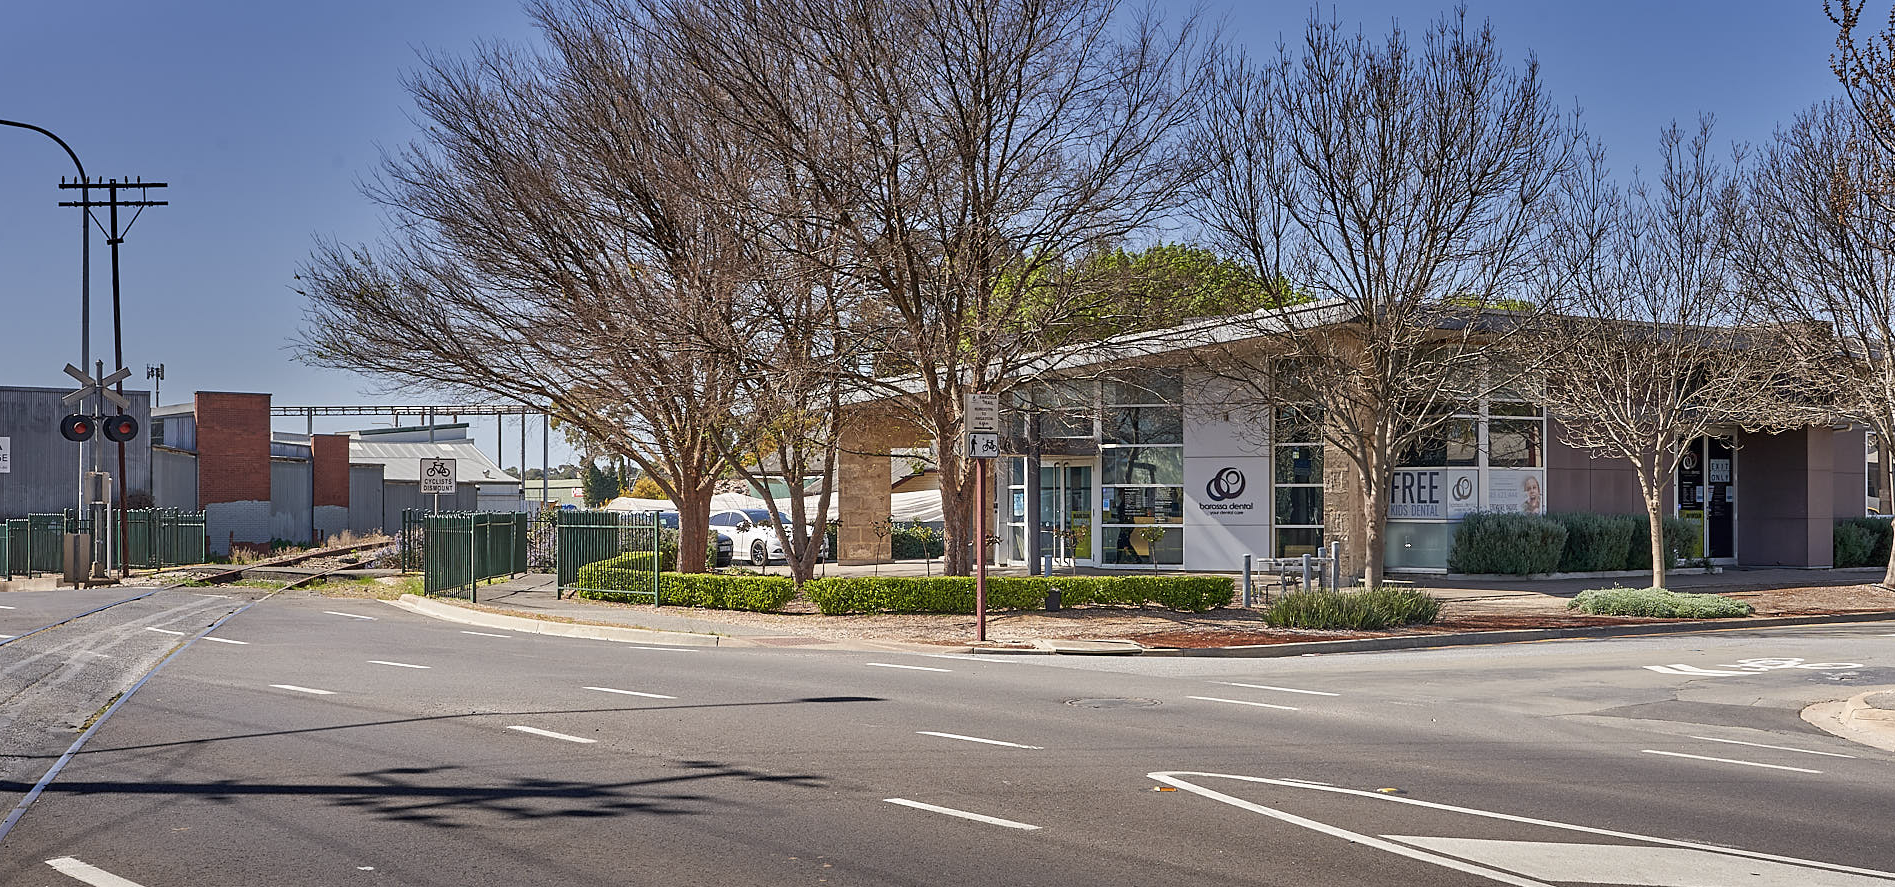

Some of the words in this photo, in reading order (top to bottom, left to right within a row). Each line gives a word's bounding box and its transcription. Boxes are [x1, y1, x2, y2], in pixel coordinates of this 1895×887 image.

[1391, 472, 1439, 503] FREE
[1199, 502, 1228, 510] barossa
[1229, 502, 1254, 510] dental
[1390, 505, 1408, 516] KIDS
[1411, 505, 1439, 516] DENTAL
